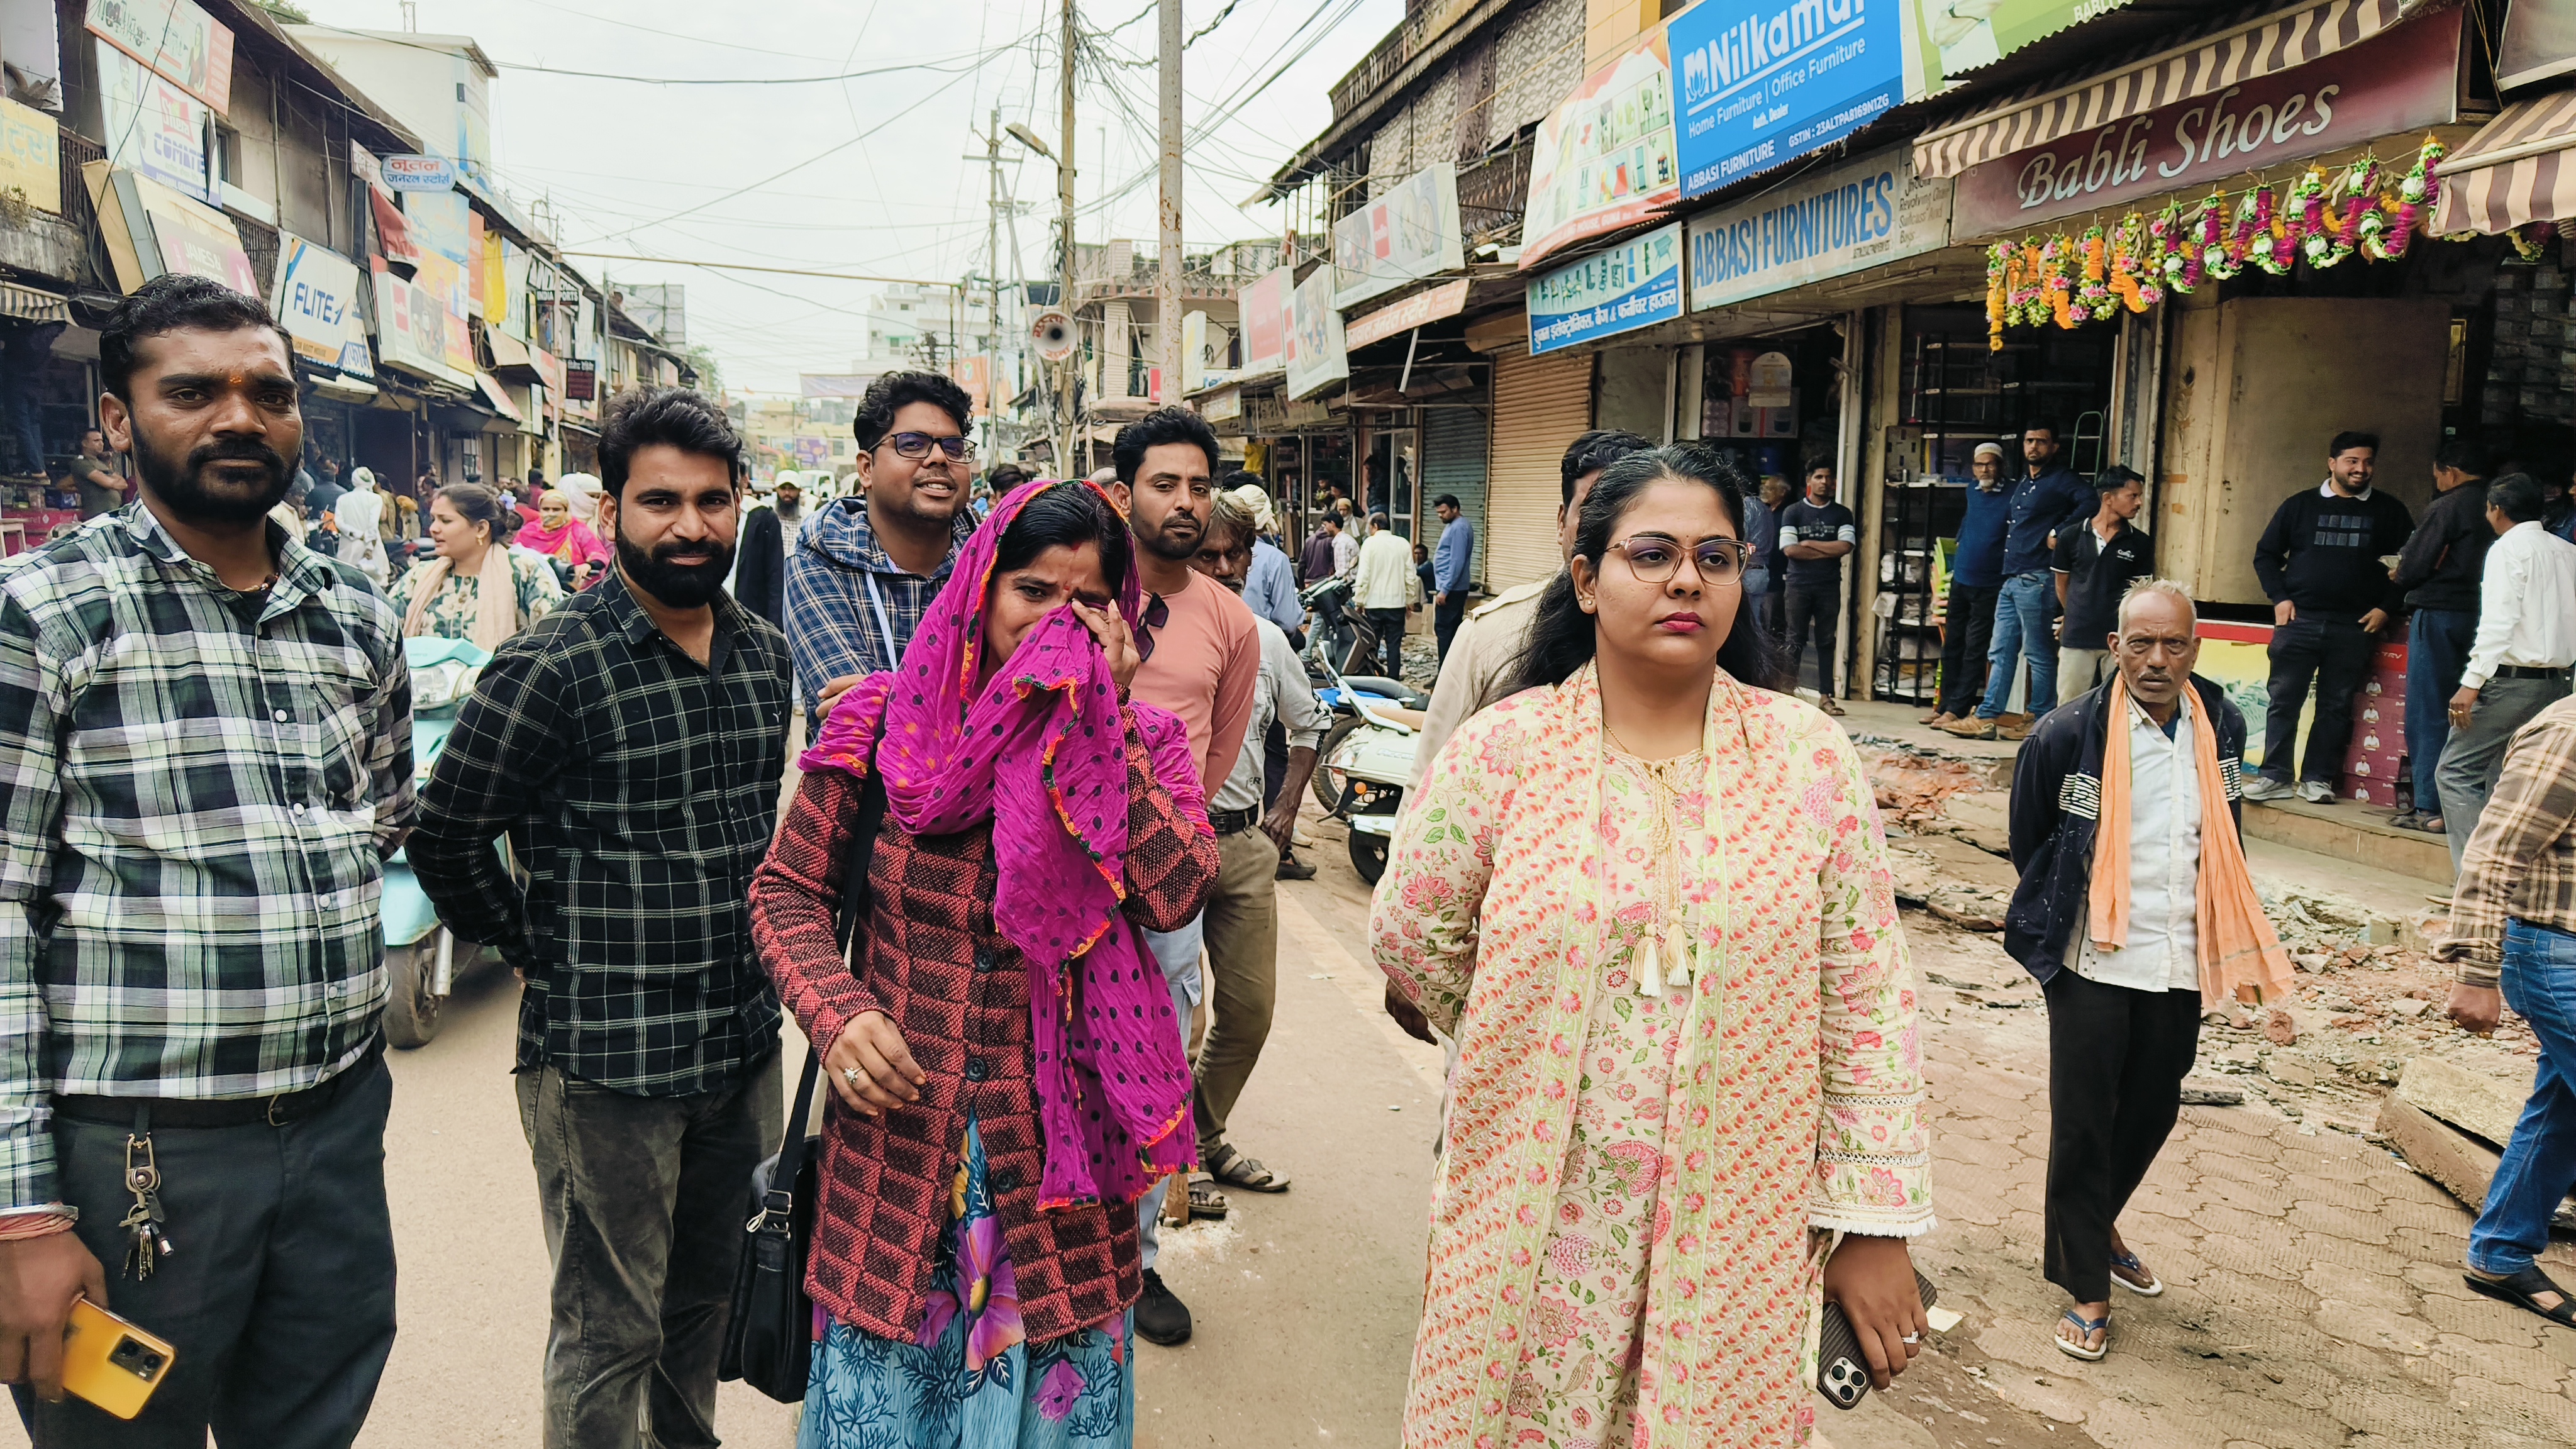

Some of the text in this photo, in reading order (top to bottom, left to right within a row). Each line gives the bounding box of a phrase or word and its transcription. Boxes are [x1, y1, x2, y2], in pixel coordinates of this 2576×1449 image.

[1709, 0, 1865, 93] Nilkama
[1689, 38, 1866, 139] Home Furniture Office Furniture
[1769, 103, 1789, 124] Dealer
[1788, 129, 1812, 148] GSTIN
[2016, 84, 2340, 210] Babli Shoes
[387, 172, 450, 184] जनरल स्टोर्स
[390, 158, 440, 173] नूतन
[1687, 139, 1775, 192] ABBASI FURNITURE
[1694, 171, 1895, 290] ABBASI FURNITURES
[294, 282, 334, 323] FLITE
